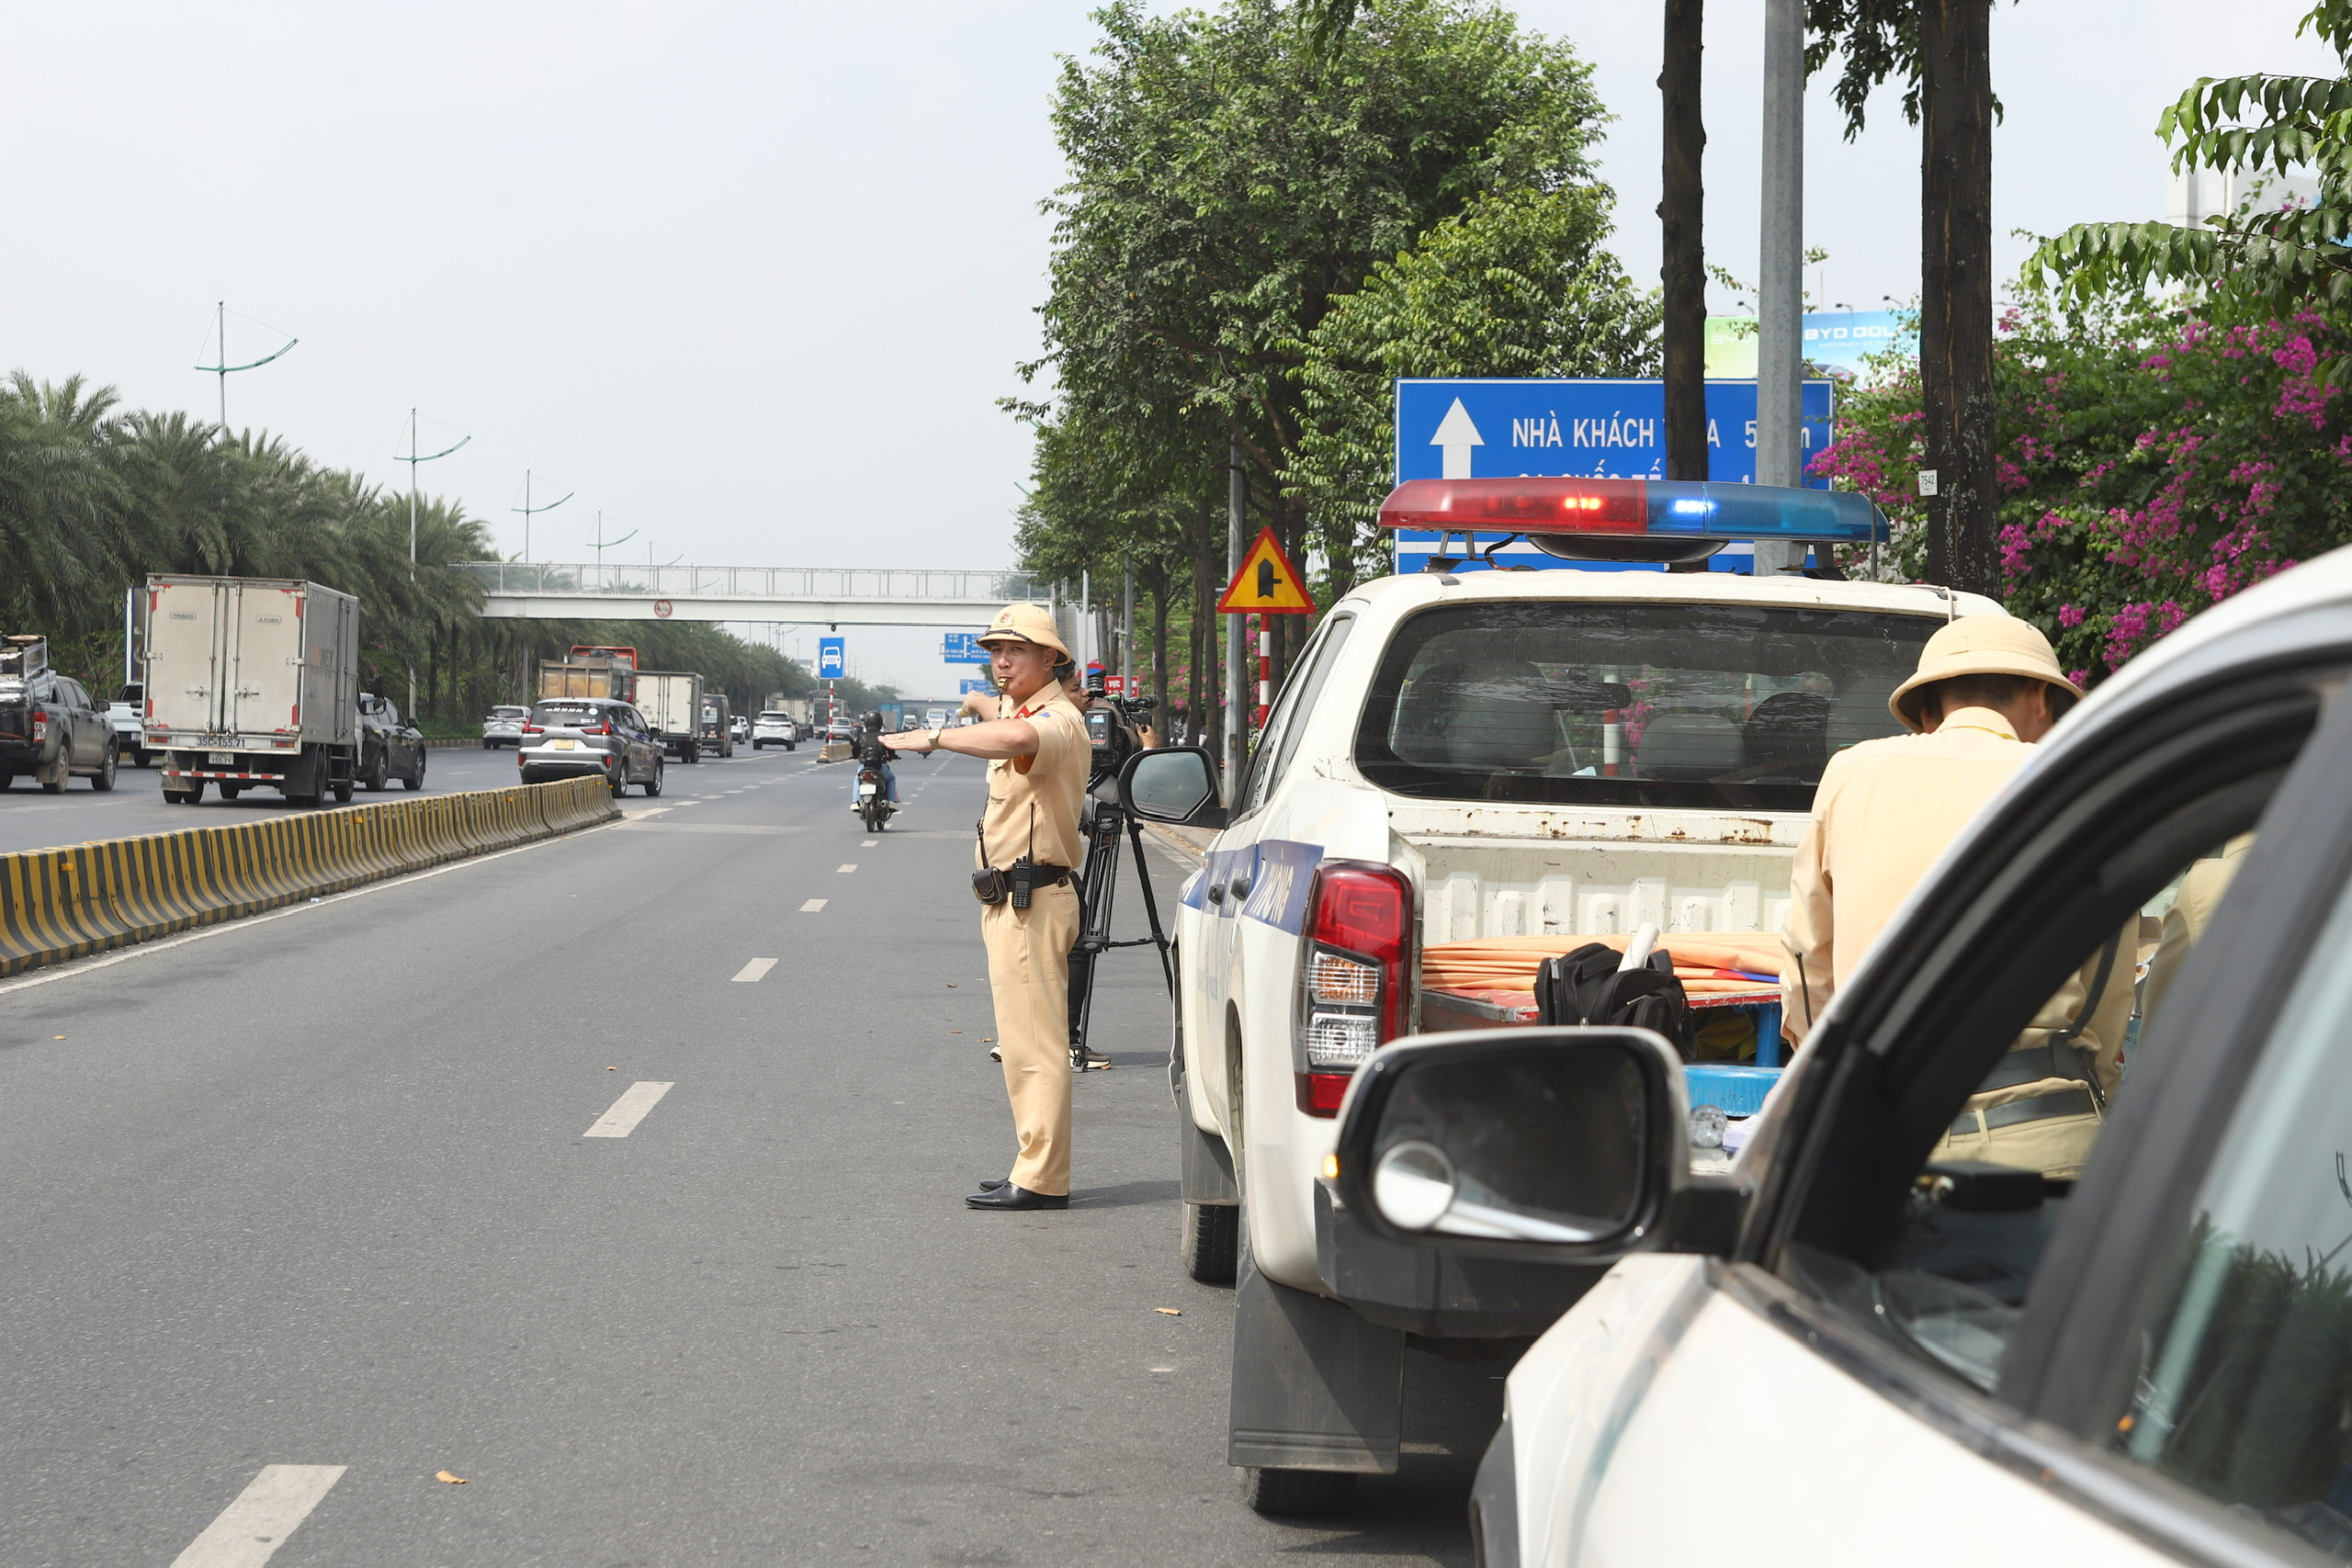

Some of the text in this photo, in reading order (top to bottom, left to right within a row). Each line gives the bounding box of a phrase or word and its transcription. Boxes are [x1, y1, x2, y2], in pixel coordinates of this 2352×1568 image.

[1804, 328, 1848, 340] BYD
[1512, 410, 1563, 447] NHÀ
[1574, 410, 1654, 447] KHÁCH
[1921, 474, 1935, 486] 7542
[197, 737, 245, 748] 35C-155.71
